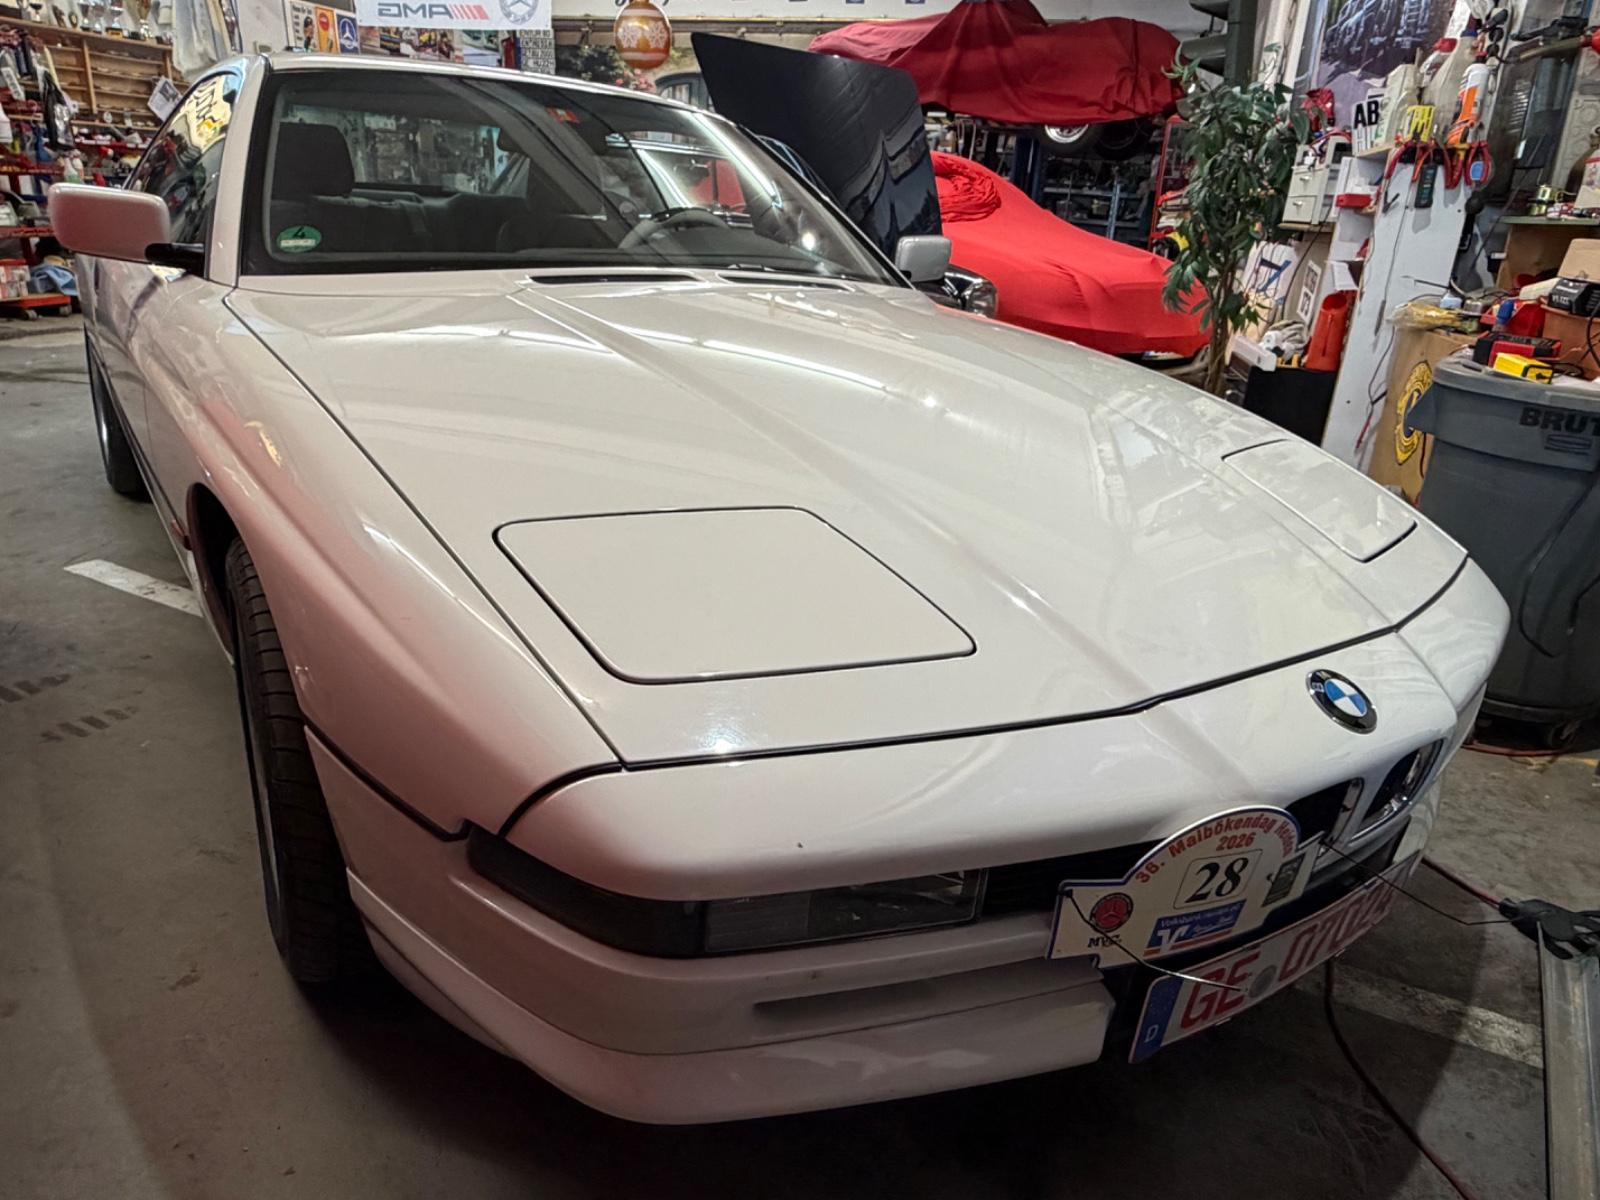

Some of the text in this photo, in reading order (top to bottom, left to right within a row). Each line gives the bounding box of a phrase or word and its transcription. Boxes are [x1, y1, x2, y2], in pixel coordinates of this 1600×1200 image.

[1185, 857, 1249, 904] 28
[1180, 950, 1260, 1029] GE
[1143, 1023, 1159, 1044] D
